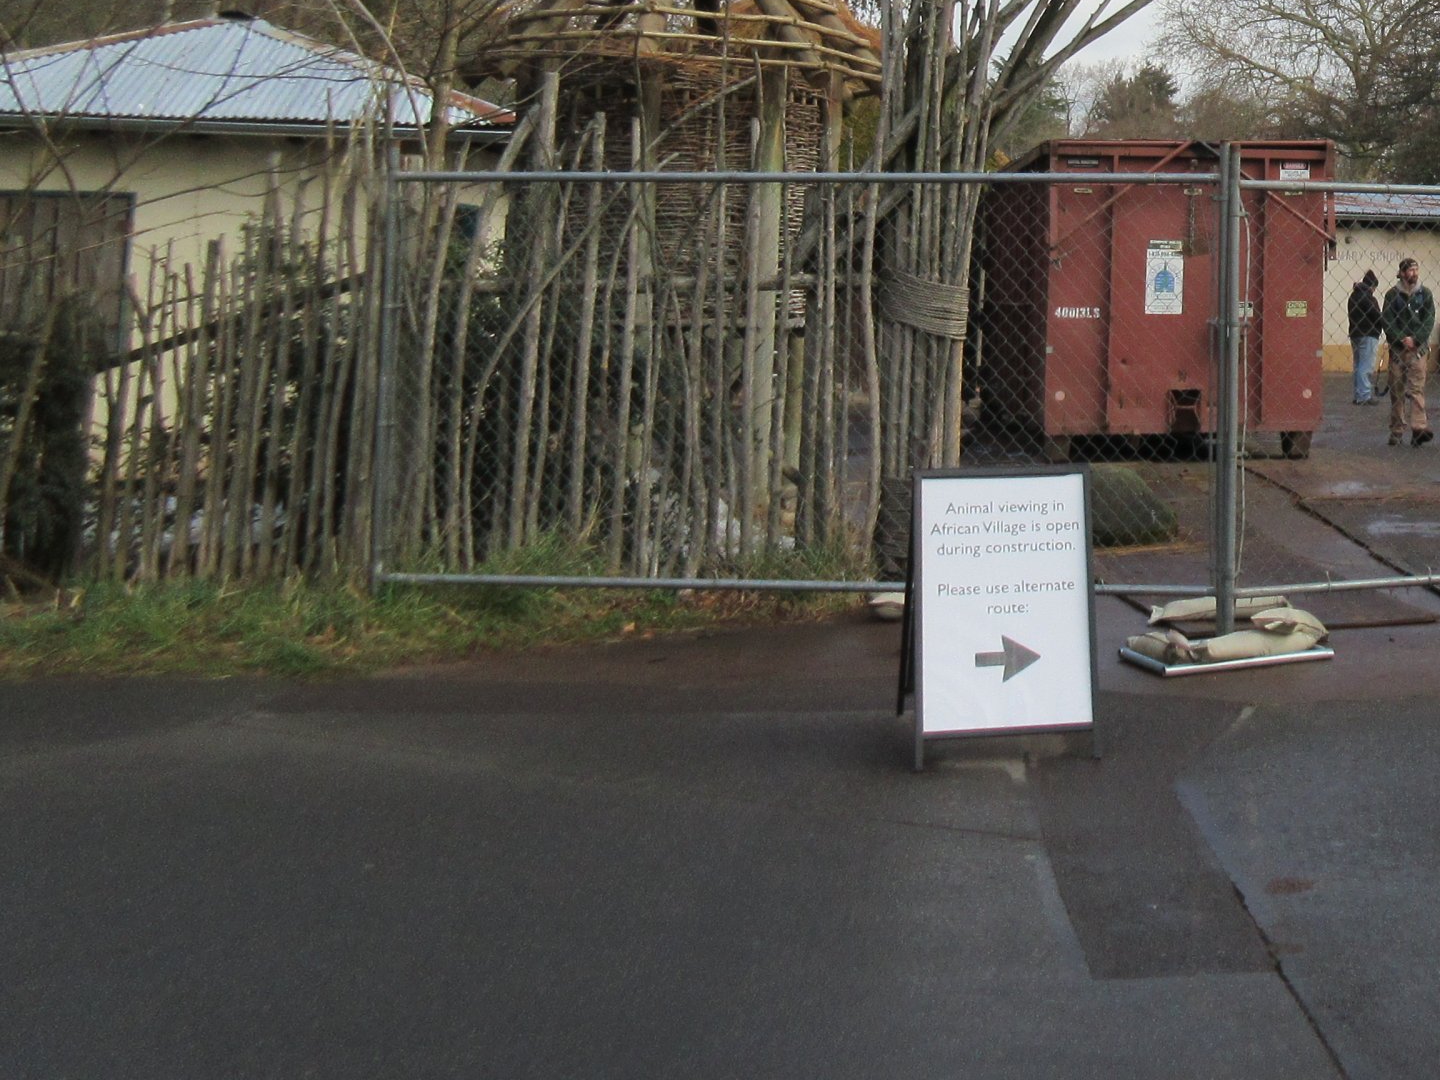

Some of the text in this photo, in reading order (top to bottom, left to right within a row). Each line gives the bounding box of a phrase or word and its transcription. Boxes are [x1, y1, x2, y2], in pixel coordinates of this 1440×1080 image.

[945, 500, 1065, 515] Animal viewing in
[930, 520, 1080, 536] African Village is open
[936, 540, 1076, 558] during construction.
[937, 580, 1075, 597] Please use alternate
[986, 602, 1030, 615] route:
